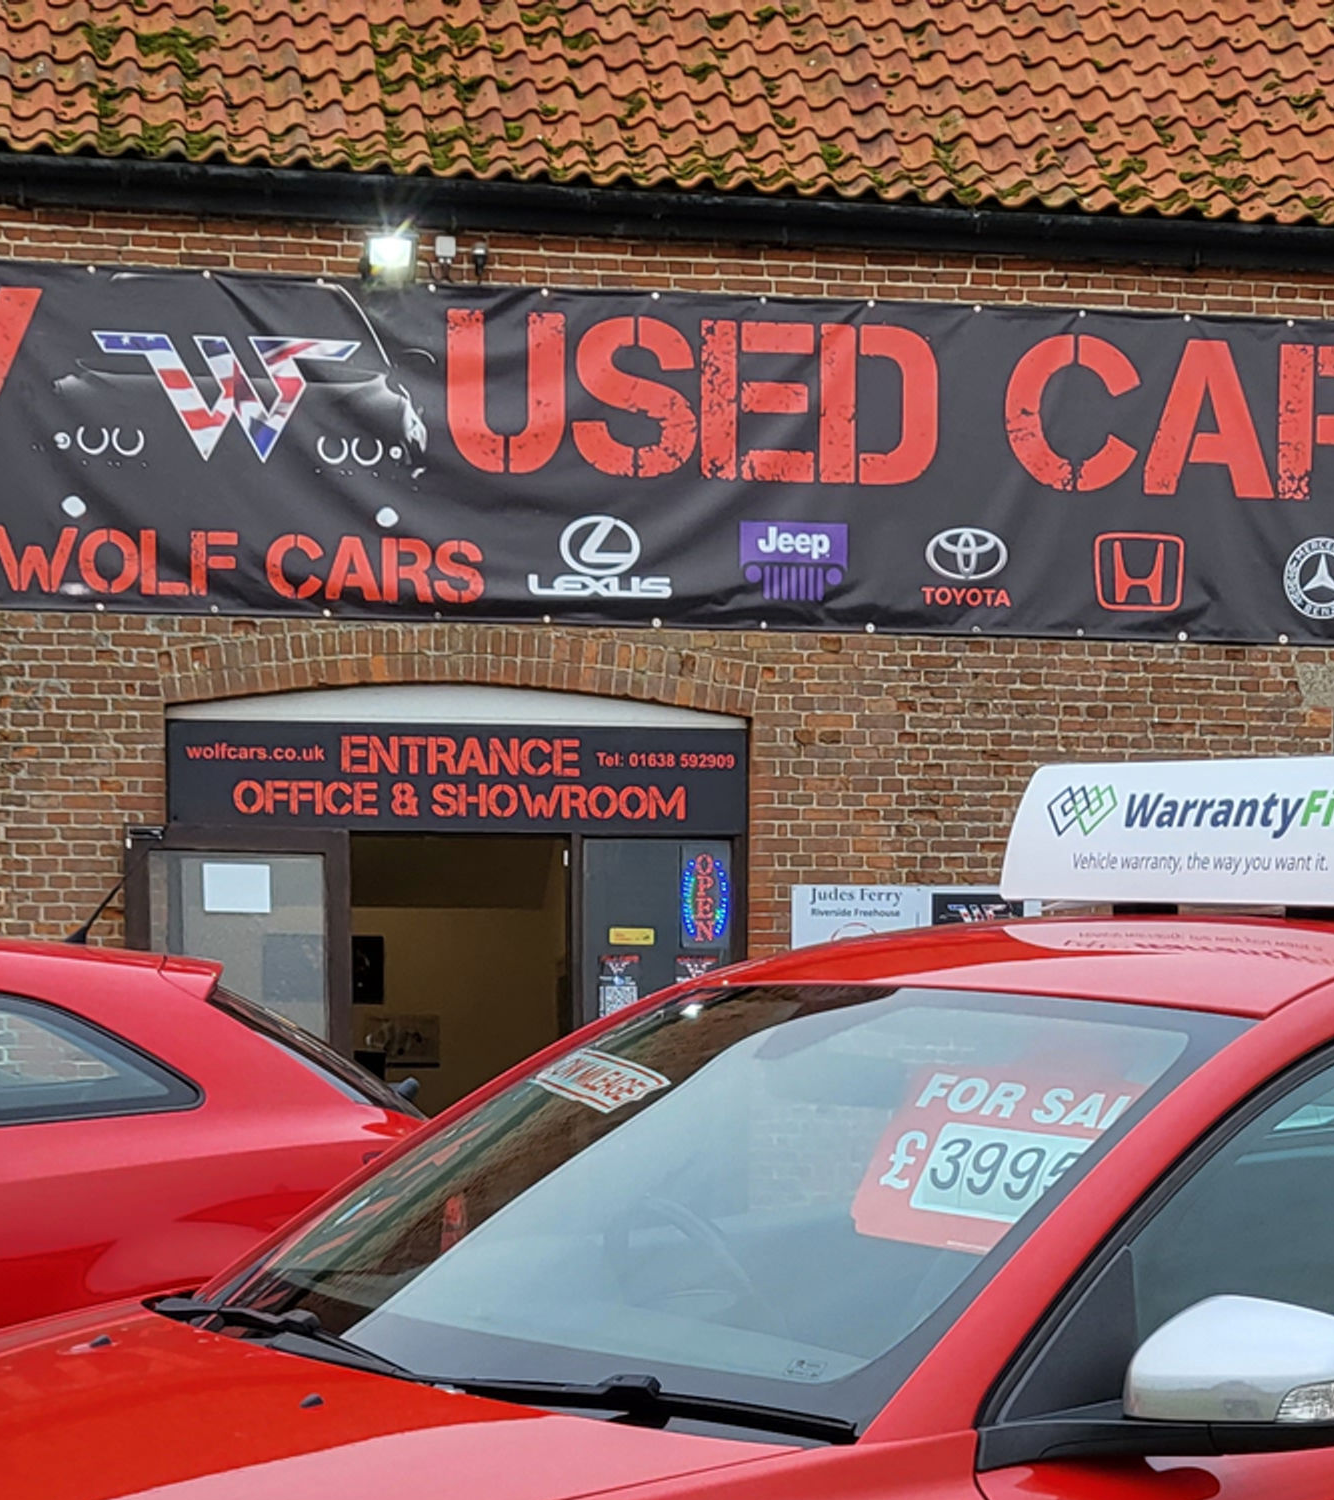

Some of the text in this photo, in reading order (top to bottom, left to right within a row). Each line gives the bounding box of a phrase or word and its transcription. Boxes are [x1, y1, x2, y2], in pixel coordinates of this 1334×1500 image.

[446, 309, 939, 486] USED
[757, 525, 831, 560] Jeep
[266, 533, 485, 604] CARS
[527, 573, 673, 599] LEXUS
[920, 585, 1012, 608] TOYOTA
[185, 735, 736, 778] wolfcars.co.uk ENTRANCE Tel: 01638 592909
[232, 778, 687, 822] OFFICE & SHOWROOM
[1071, 851, 1329, 874] Vehicle warranty, the way you want it.
[694, 853, 715, 942] OPEN
[810, 887, 903, 905] Judes Ferry
[811, 907, 901, 918] Riverside Freehouse
[915, 1073, 1027, 1119] FOR
